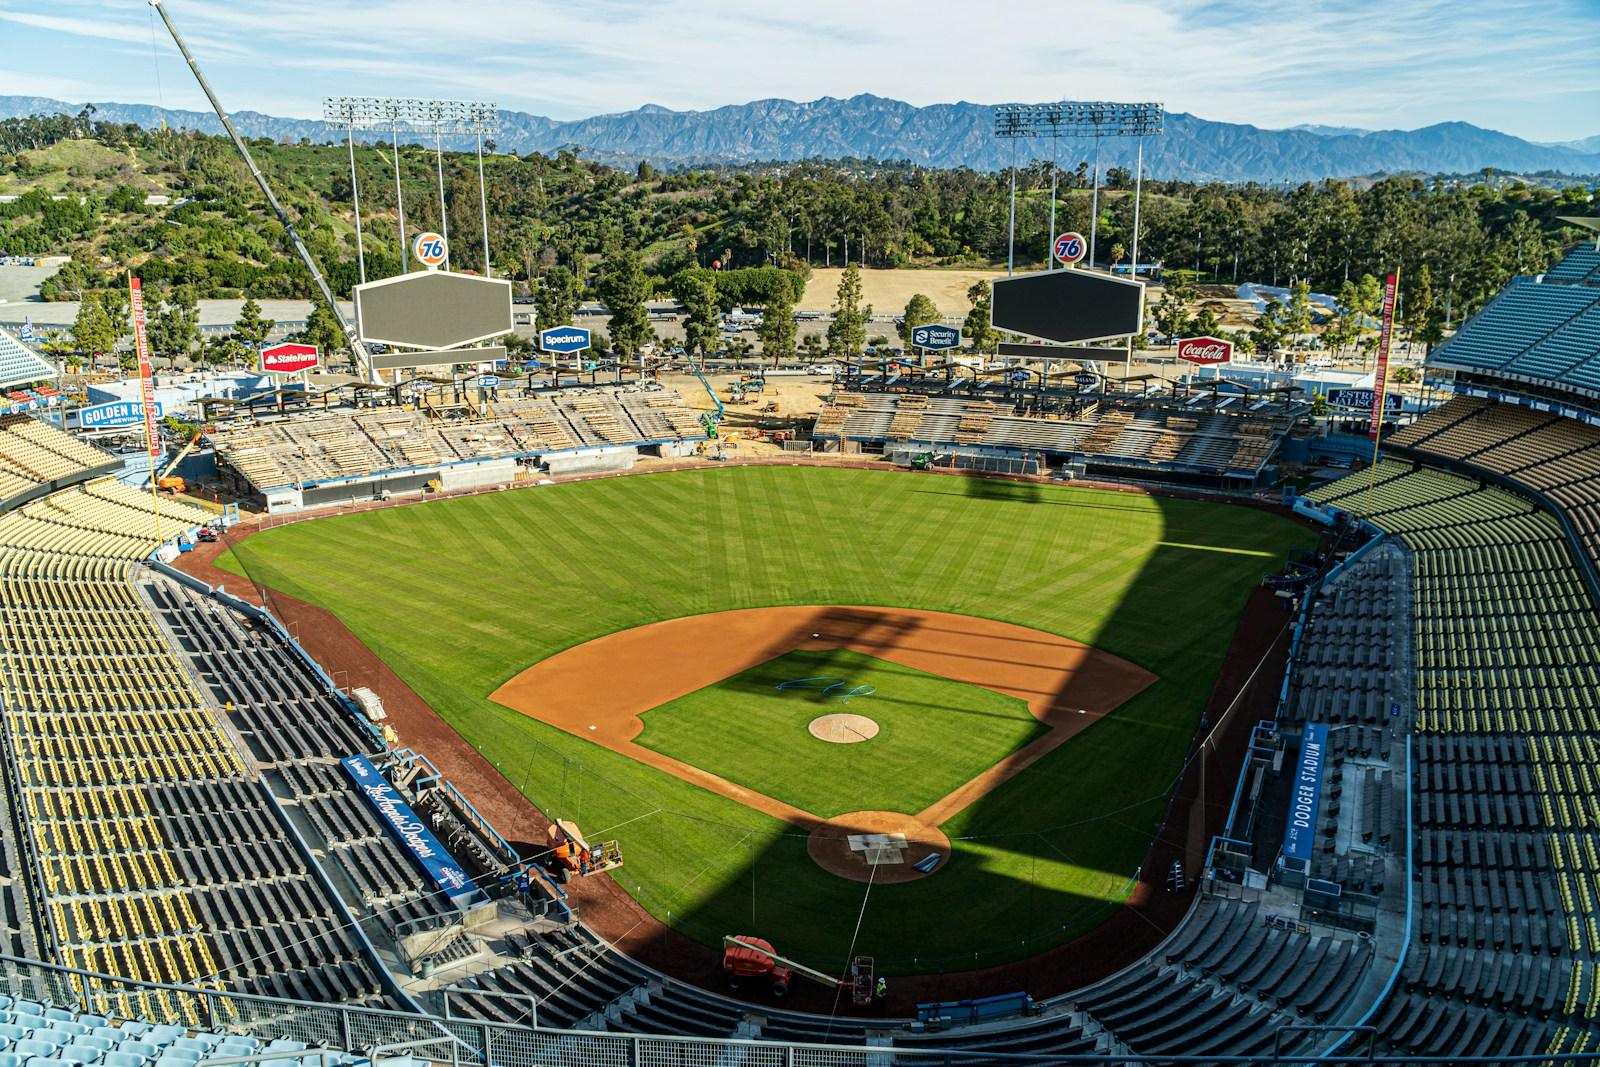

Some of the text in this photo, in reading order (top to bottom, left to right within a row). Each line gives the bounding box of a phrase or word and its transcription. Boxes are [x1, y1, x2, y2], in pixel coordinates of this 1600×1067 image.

[422, 240, 443, 258] 76
[1058, 239, 1080, 257] 76
[545, 335, 584, 346] Spectrum
[930, 330, 956, 341] Security
[1333, 397, 1373, 408] JALISC
[85, 403, 161, 424] GOLDEN ROD
[109, 417, 139, 425] BREWING
[1301, 743, 1321, 783] STADIUM
[1294, 785, 1315, 828] DODGER
[374, 796, 409, 829] Angeles
[400, 823, 436, 858] Dodgers
